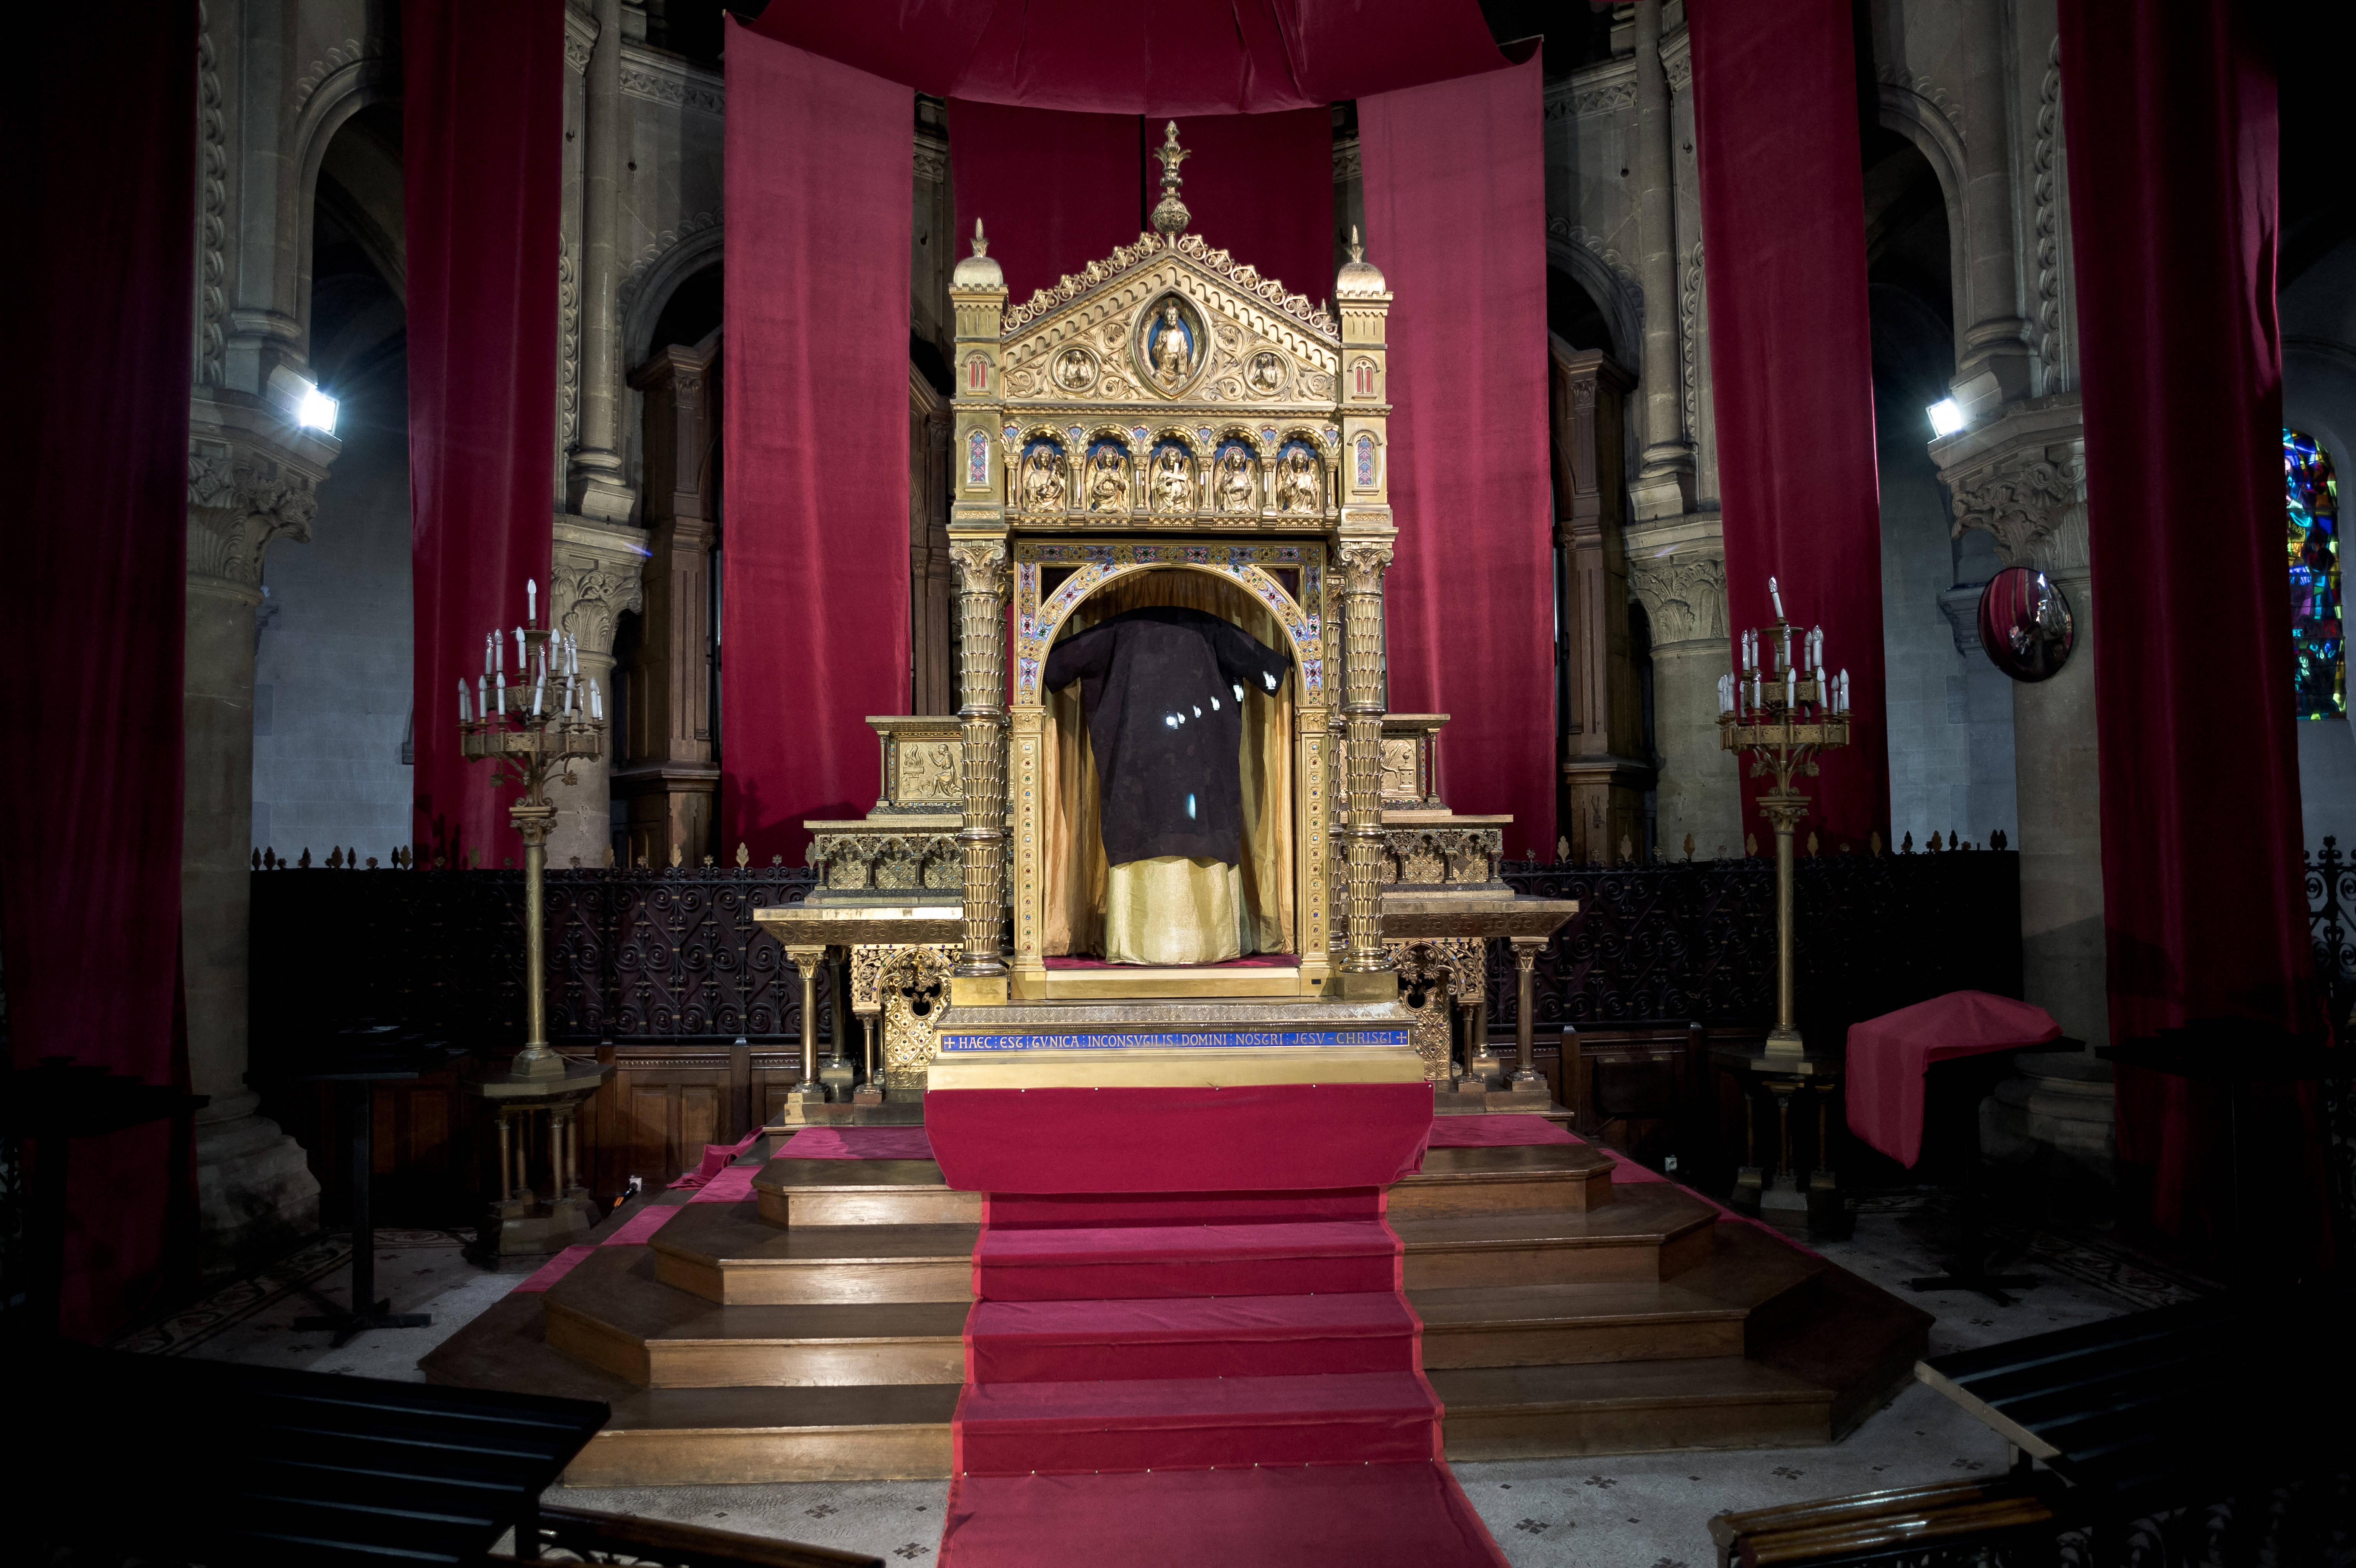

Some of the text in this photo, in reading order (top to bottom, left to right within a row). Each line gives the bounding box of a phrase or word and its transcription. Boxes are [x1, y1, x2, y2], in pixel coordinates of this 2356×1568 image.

[959, 1032, 1392, 1048] HAEC EST TVNICA INCONSVTILIS DOMINI NOSTRI JESV CHRISTI
